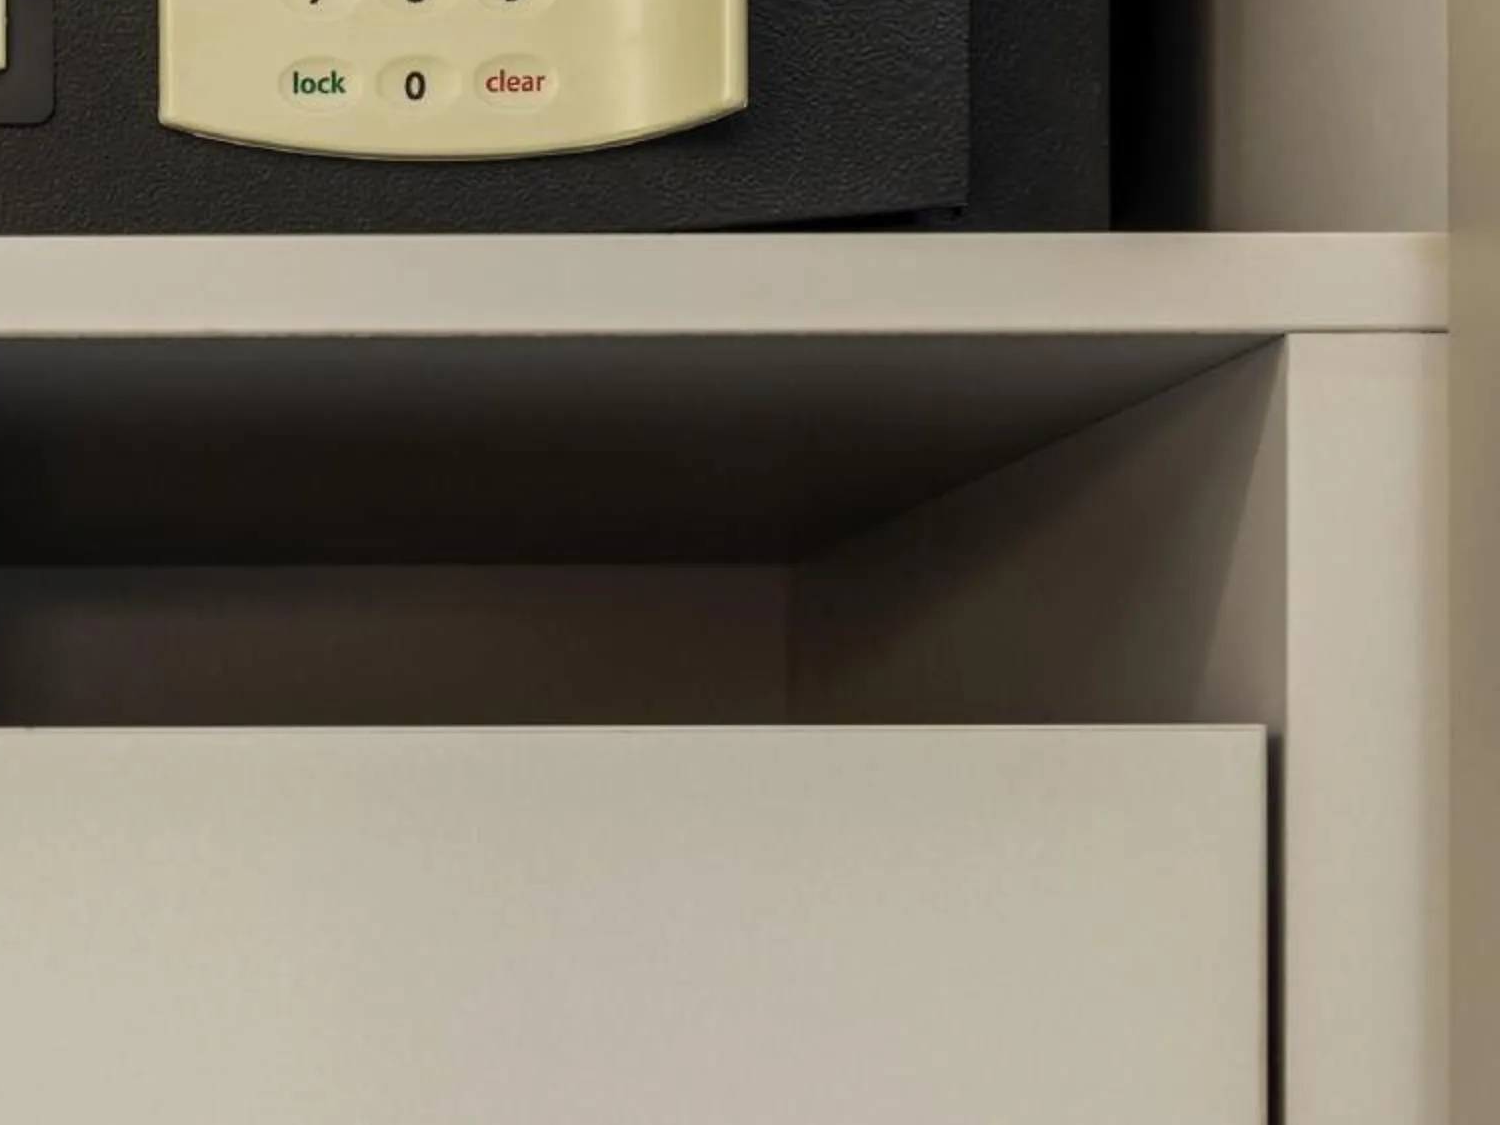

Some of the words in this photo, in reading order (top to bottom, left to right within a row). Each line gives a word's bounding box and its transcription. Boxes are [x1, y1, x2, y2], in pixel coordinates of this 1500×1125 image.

[292, 70, 346, 95] lock
[404, 71, 426, 101] 0
[485, 71, 546, 93] clear
